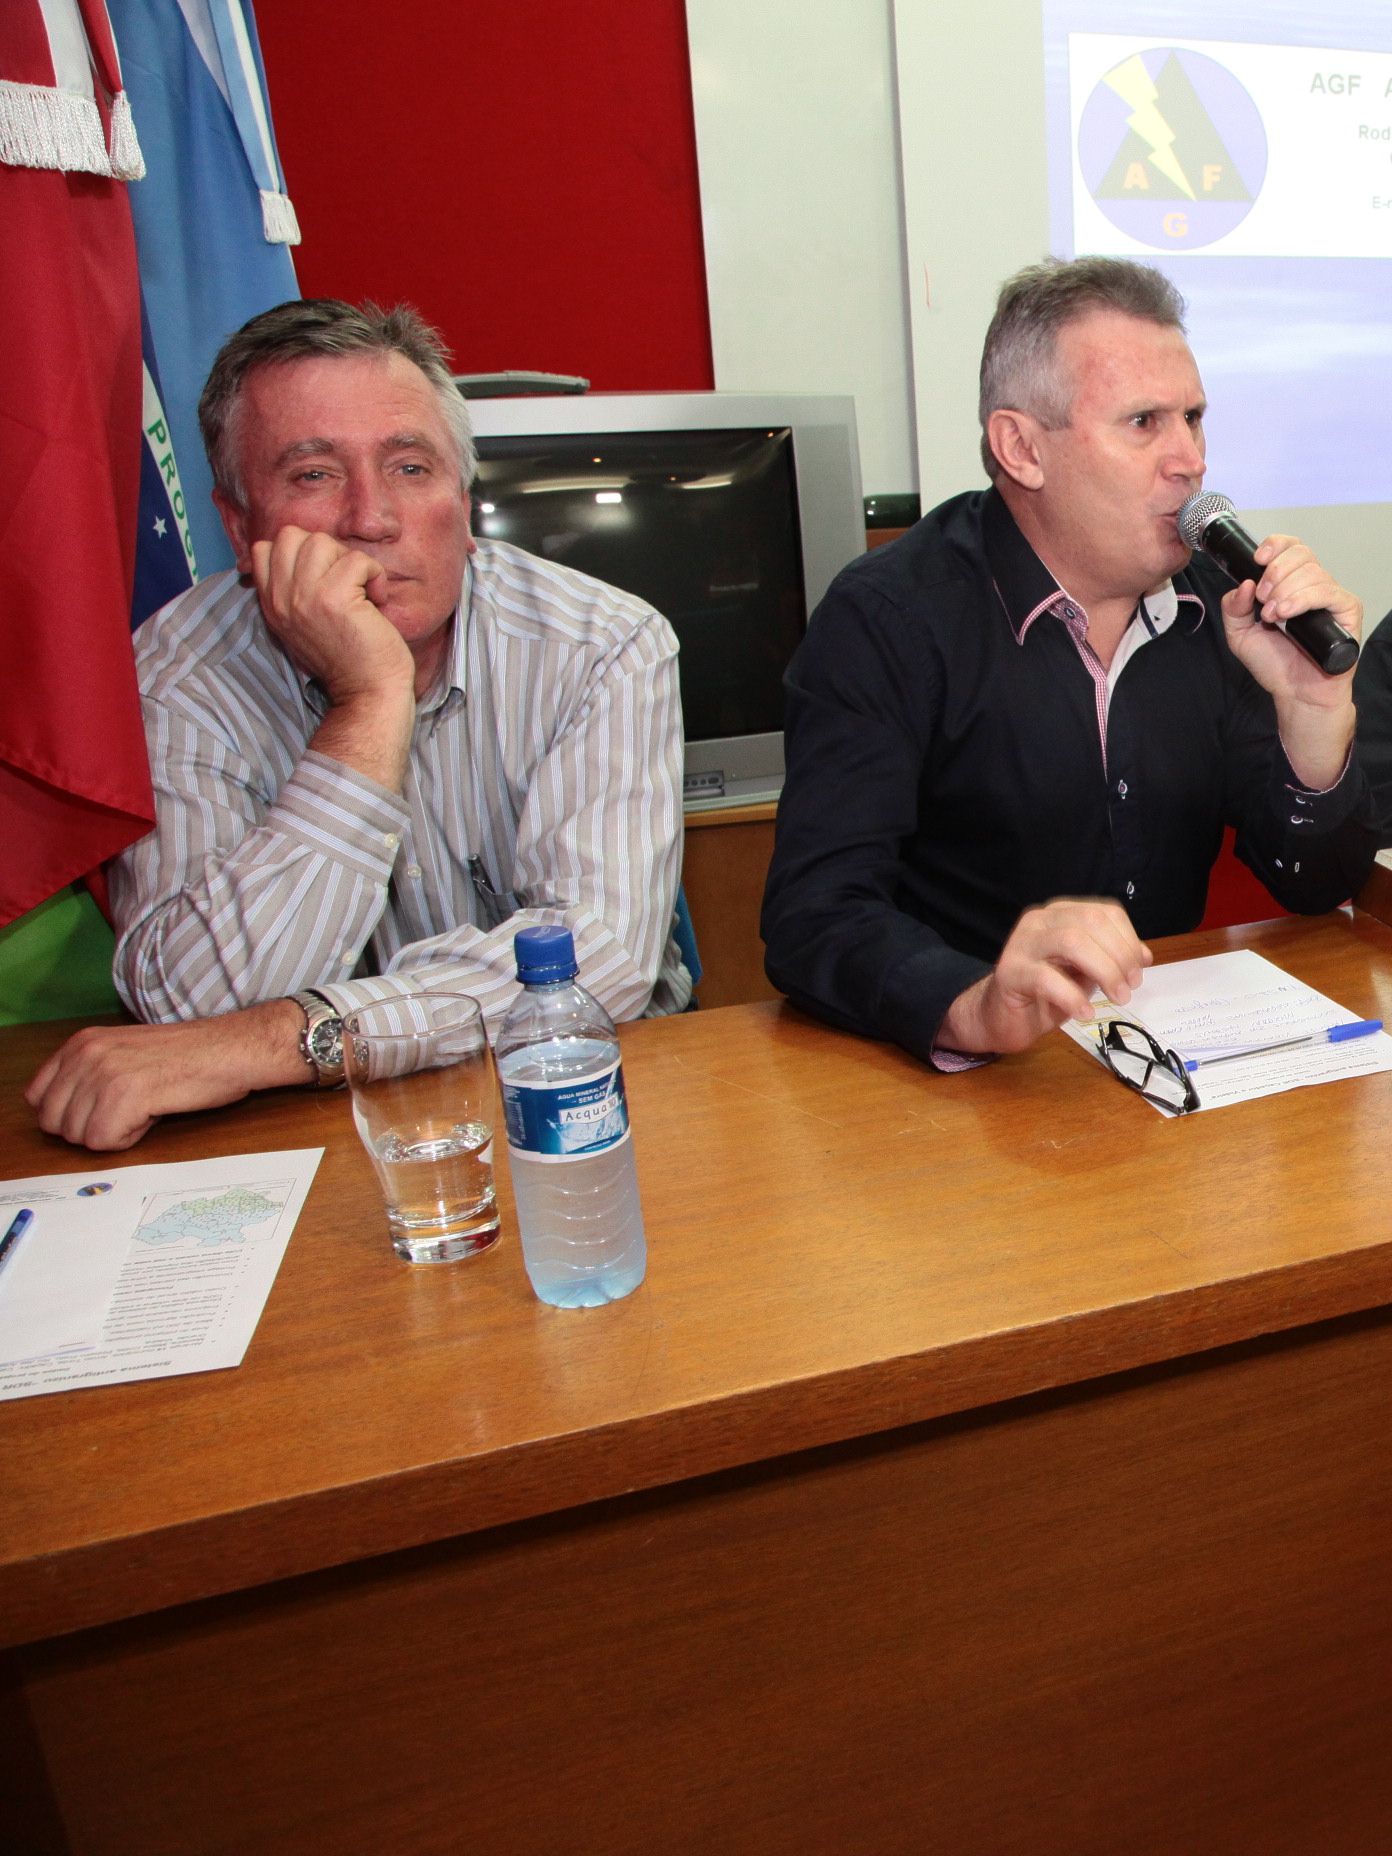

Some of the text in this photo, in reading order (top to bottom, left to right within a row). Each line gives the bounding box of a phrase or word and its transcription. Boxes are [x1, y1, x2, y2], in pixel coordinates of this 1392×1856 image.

[1309, 72, 1362, 96] AGF
[1123, 162, 1223, 191] A F
[1162, 213, 1189, 237] G
[147, 418, 200, 577] PROG
[565, 1104, 607, 1122] Acqua
